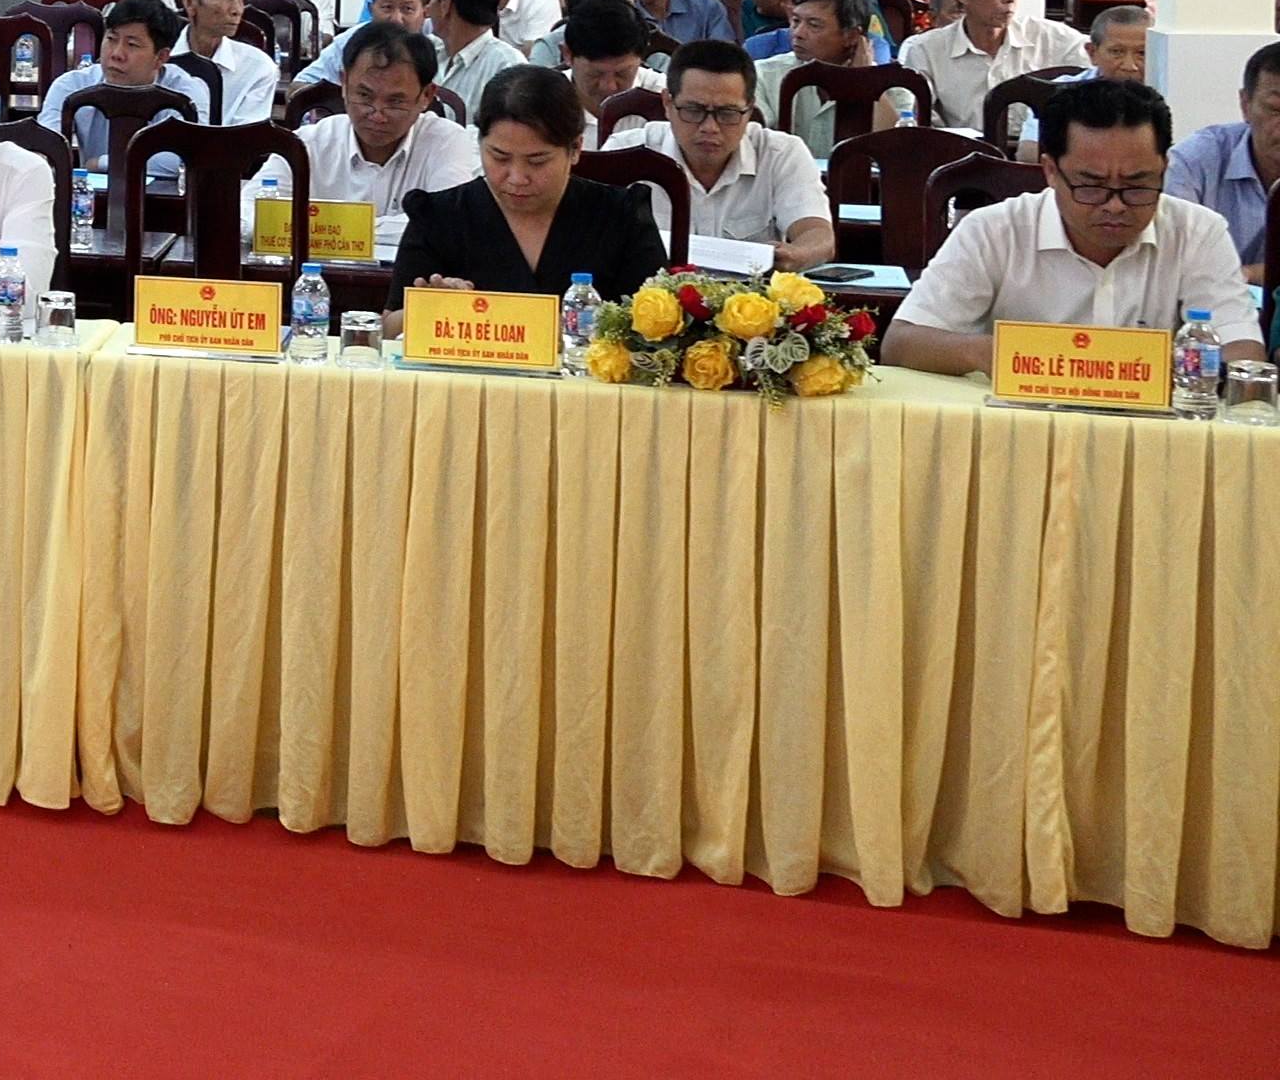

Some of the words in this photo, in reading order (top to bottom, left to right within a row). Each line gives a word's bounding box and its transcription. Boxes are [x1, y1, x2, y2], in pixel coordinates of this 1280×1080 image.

[150, 304, 177, 325] ÔNG:
[180, 304, 227, 329] NGUYỄN
[230, 308, 245, 329] ÚT
[248, 313, 266, 330] EM
[435, 317, 454, 339] BÀ:
[458, 322, 472, 344] TẠ
[476, 320, 491, 341] BÉ
[495, 324, 526, 343] LOAN
[1012, 352, 1045, 376] ÔNG:
[1049, 354, 1065, 376] LÊ
[1069, 359, 1115, 380] TRUNG
[1119, 357, 1151, 382] HIẾU
